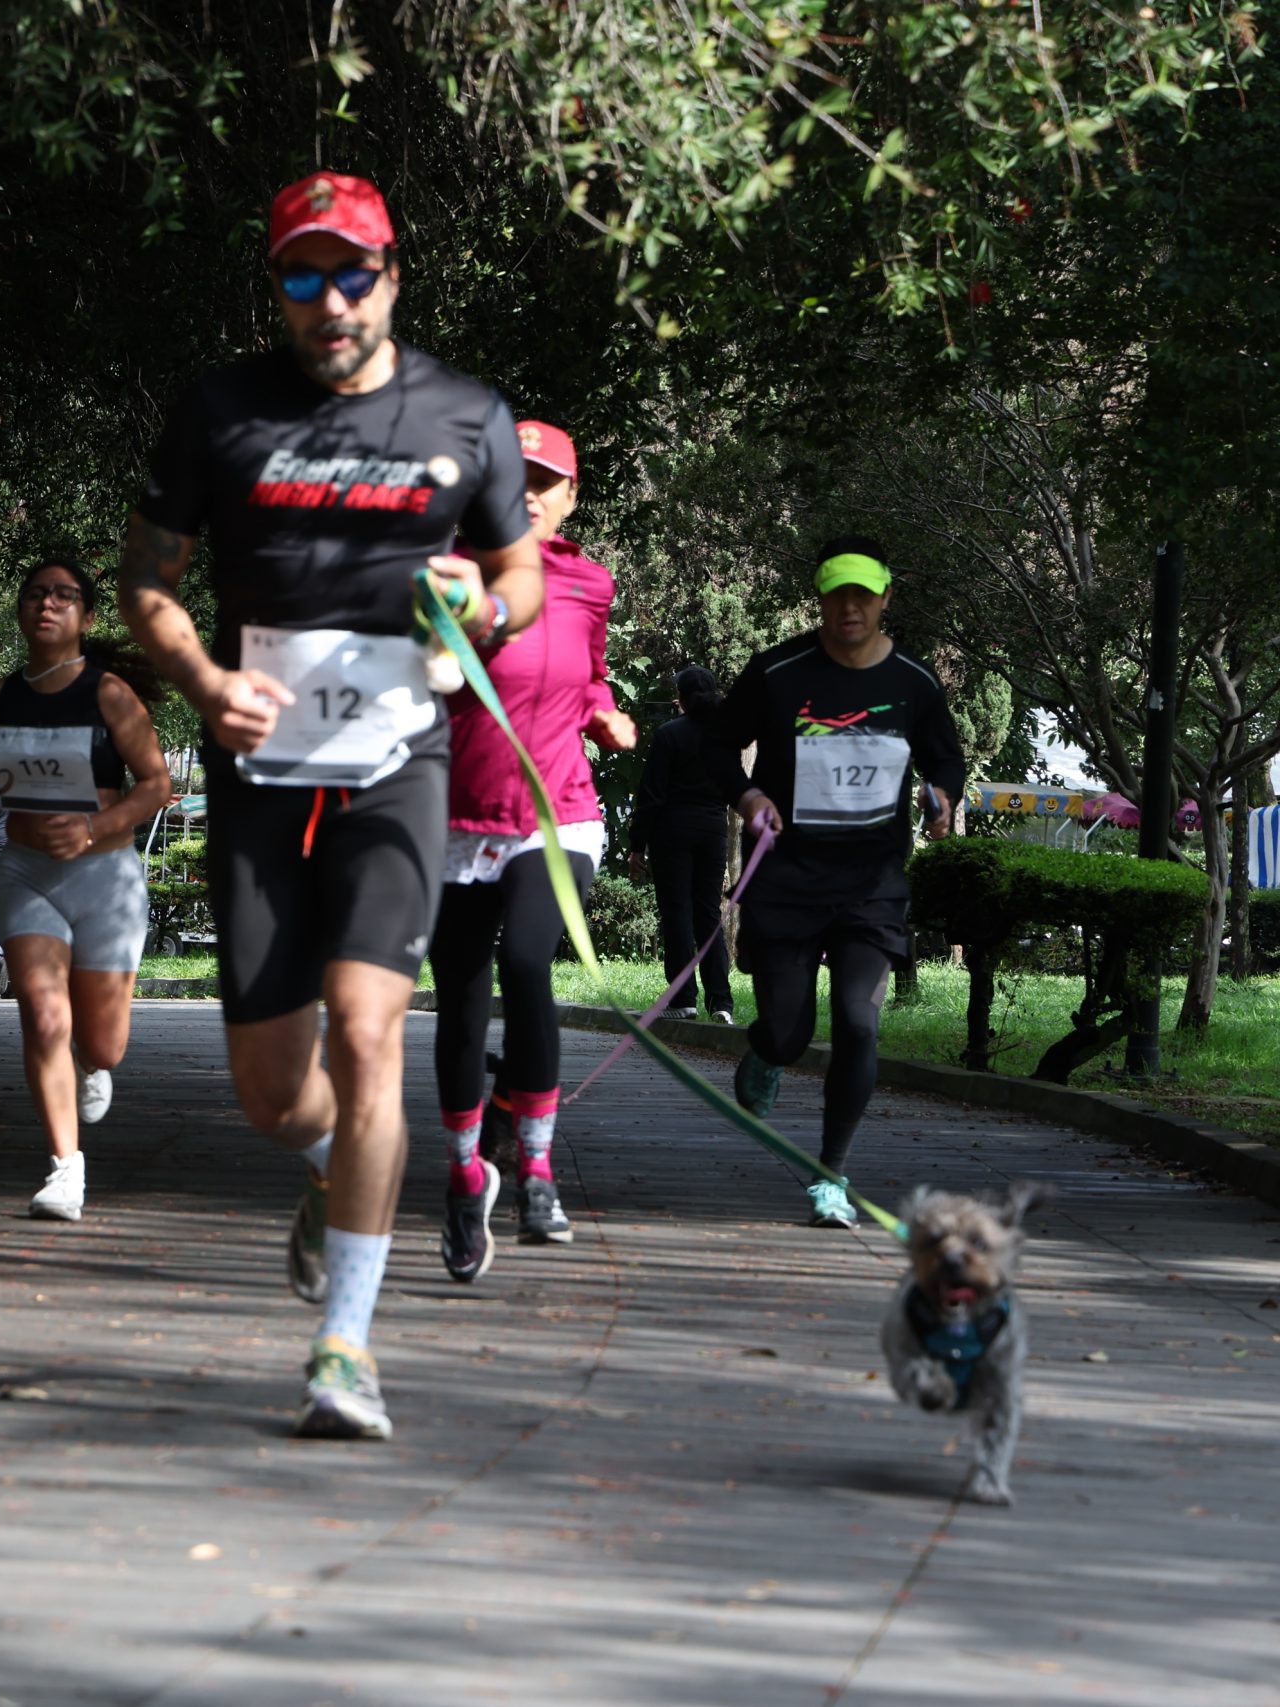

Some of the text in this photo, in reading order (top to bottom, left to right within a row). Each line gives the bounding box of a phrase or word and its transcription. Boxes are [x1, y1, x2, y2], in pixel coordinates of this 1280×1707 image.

[343, 482, 434, 515] RACE
[312, 686, 362, 721] 12
[18, 758, 65, 778] 112
[832, 765, 879, 787] 127
